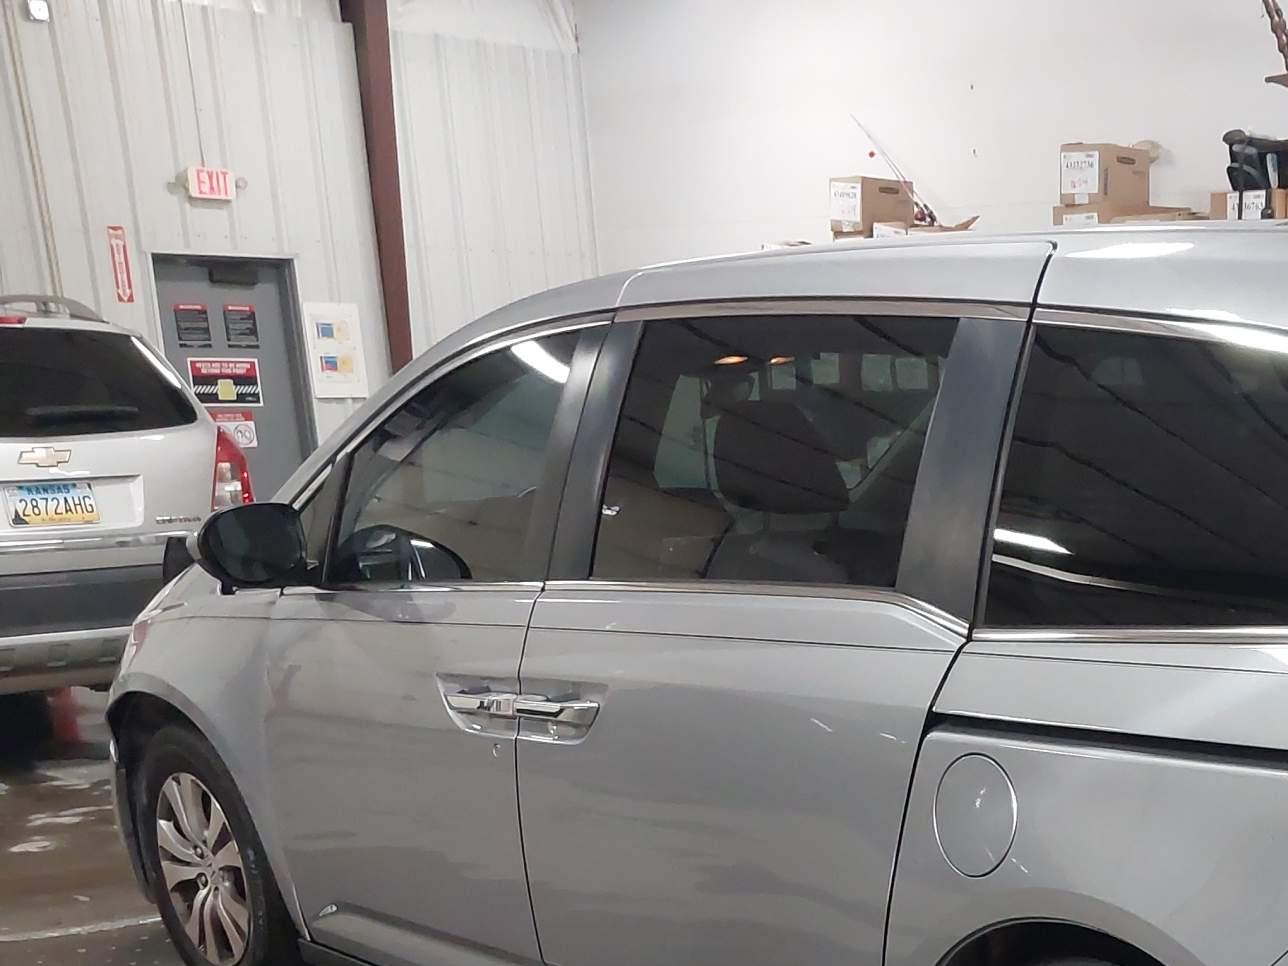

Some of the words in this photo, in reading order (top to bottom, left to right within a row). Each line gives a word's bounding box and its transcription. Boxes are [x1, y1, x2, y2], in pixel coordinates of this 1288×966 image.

[197, 168, 230, 196] EXIT
[26, 484, 71, 495] KANSAS
[19, 495, 95, 517] 2872AHG
